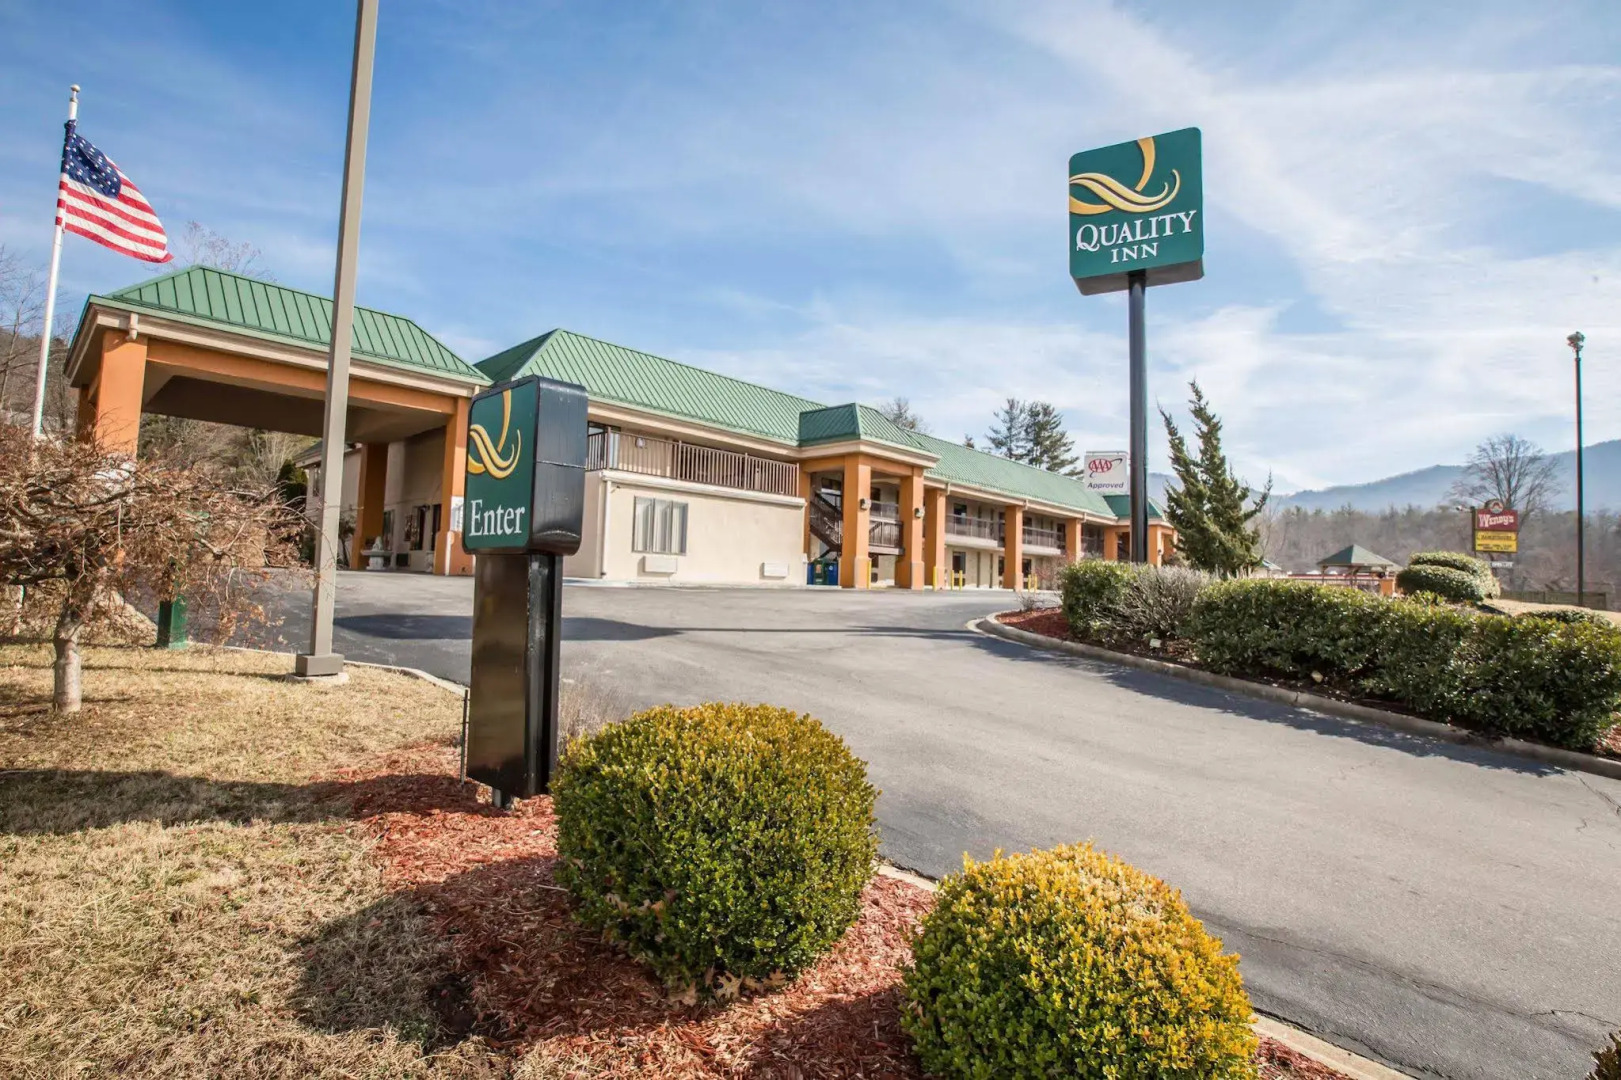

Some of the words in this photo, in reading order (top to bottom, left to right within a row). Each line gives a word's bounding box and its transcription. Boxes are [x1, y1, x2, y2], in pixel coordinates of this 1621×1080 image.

[1076, 210, 1197, 251] QUALITY
[1110, 242, 1159, 263] INN
[1090, 459, 1111, 473] AAA
[468, 499, 526, 537] Enter
